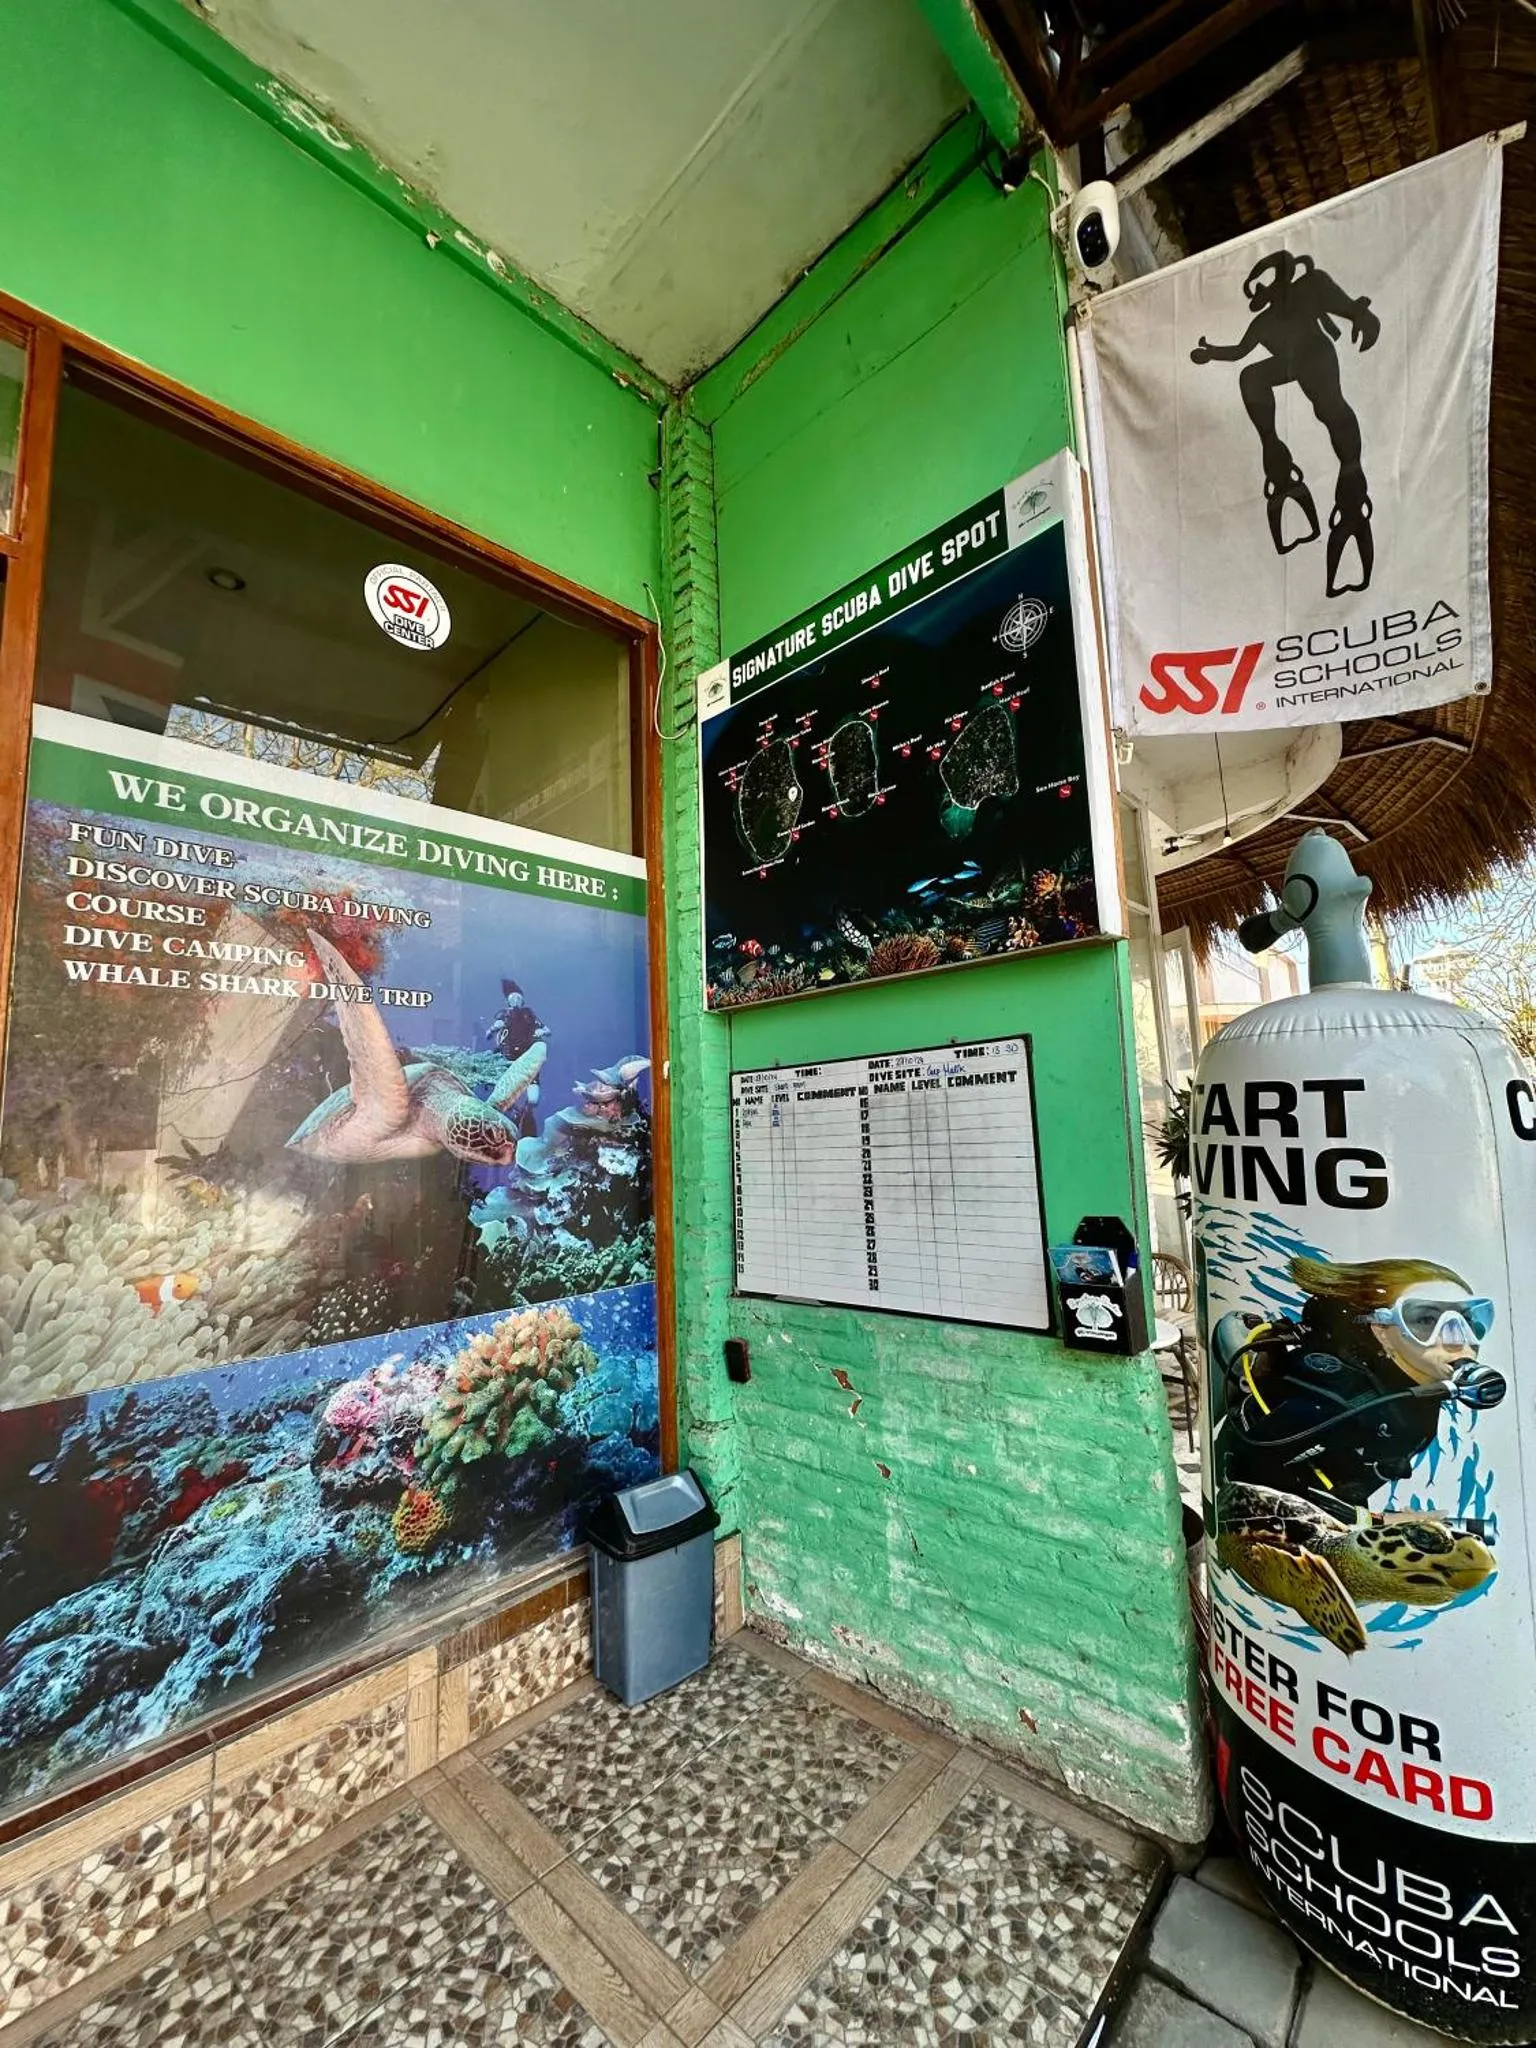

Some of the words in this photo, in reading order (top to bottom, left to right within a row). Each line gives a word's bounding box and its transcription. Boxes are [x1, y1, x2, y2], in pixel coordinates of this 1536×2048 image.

[369, 566, 404, 585] OFFICIAL
[731, 622, 817, 688] SIGNATURE
[821, 584, 882, 637] SCUBA
[887, 551, 935, 597] DIVE
[940, 510, 1001, 566] SPOT
[383, 584, 429, 618] SSI
[394, 614, 425, 634] DIVE
[384, 621, 434, 648] CENTER
[1276, 599, 1461, 663] SCUBA
[1139, 641, 1265, 715] SSI
[1274, 628, 1463, 689] SCHOOLS
[1276, 657, 1465, 709] INTERNATIONAL
[68, 821, 145, 854] FUN
[154, 834, 235, 870] DIVE
[108, 769, 187, 814] WE
[200, 791, 408, 859] ORGANIZE
[419, 838, 531, 885] DIVING
[536, 864, 606, 900] HERE
[65, 890, 206, 927] COURSE
[66, 856, 236, 901] DISCOVER
[244, 884, 336, 916] SCUBA
[341, 896, 432, 929] DIVING
[62, 924, 152, 955] DIVE
[162, 937, 306, 970] CAMPING
[63, 960, 191, 991] WHALE
[200, 973, 302, 1000] SHARK
[308, 982, 373, 1005] DIVE
[379, 988, 434, 1010] TRIP
[795, 1067, 822, 1078] TIME:
[868, 1058, 894, 1069] DATE:
[869, 1070, 893, 1082] DIVE
[954, 1047, 989, 1059] TIME:
[745, 1096, 763, 1105] NAME
[771, 1093, 790, 1103] LEVEL
[796, 1086, 857, 1102] COMMENT
[873, 1081, 905, 1095] NAME
[911, 1078, 942, 1091] LEVEL
[947, 1070, 1018, 1089] COMMENT
[860, 1109, 868, 1121] 17
[1211, 1600, 1300, 1705] STER
[1316, 1680, 1442, 1763] FOR
[1214, 1639, 1297, 1748] FREE
[1312, 1726, 1494, 1822] CARD
[1240, 1765, 1520, 1936] SCUBA
[1244, 1809, 1521, 1979] SCHOOLS
[1248, 1844, 1520, 2010] INTERNATIONAL
